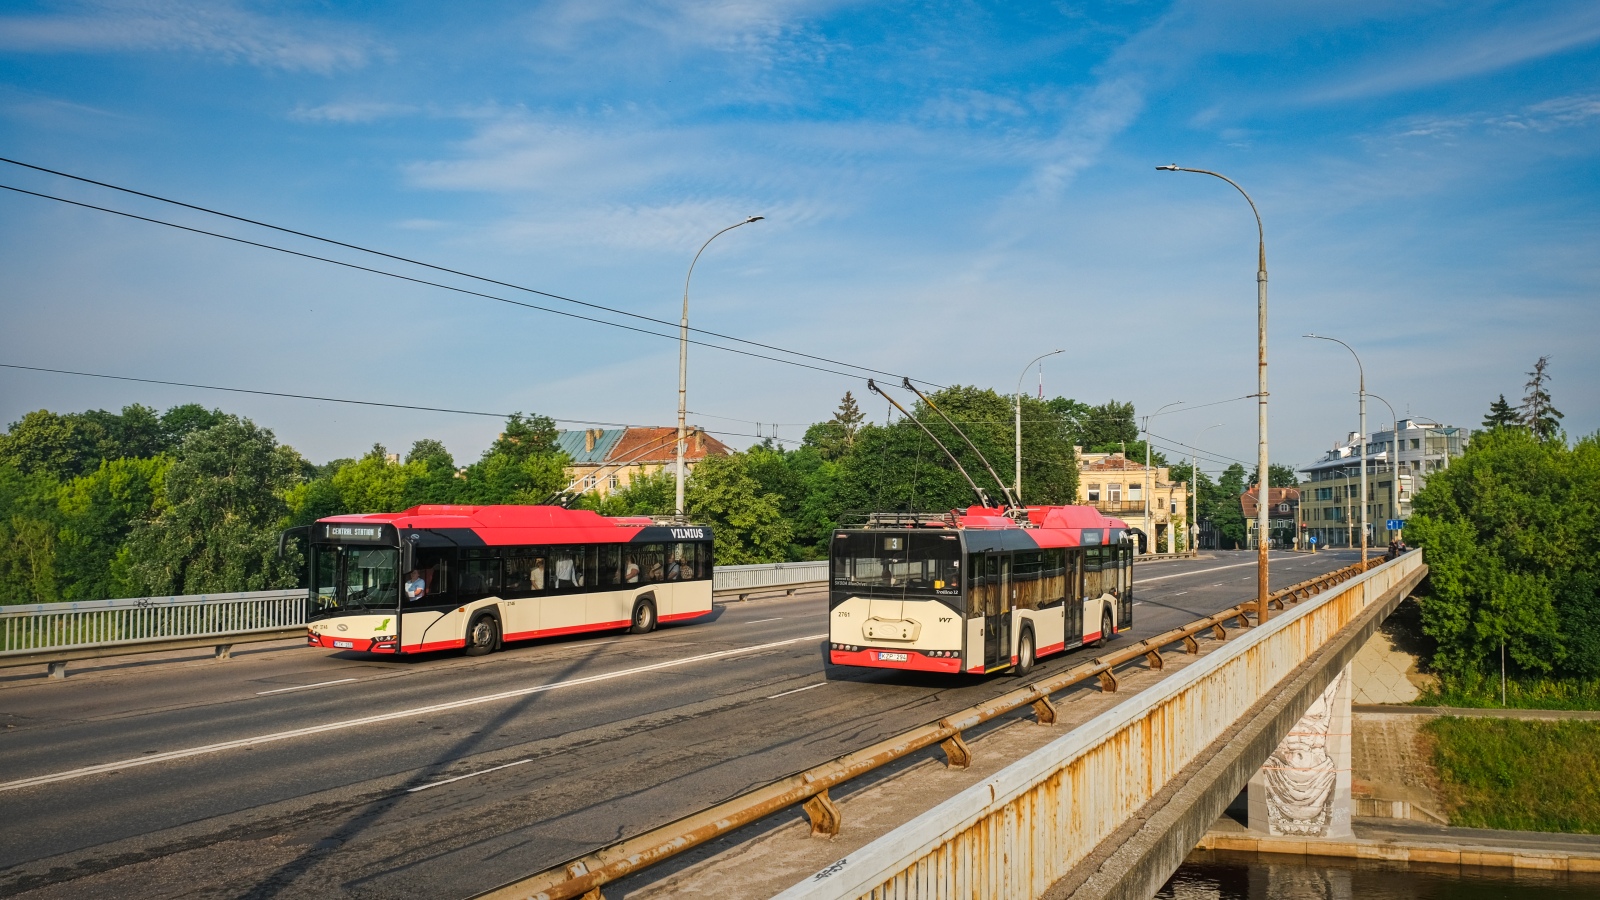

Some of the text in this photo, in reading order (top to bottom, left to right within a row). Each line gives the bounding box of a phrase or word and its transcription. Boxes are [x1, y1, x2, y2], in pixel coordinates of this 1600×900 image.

[332, 527, 352, 535] CENTRAL
[354, 528, 375, 536] STATION
[670, 528, 704, 539] VILNIUS
[892, 538, 898, 549] 3
